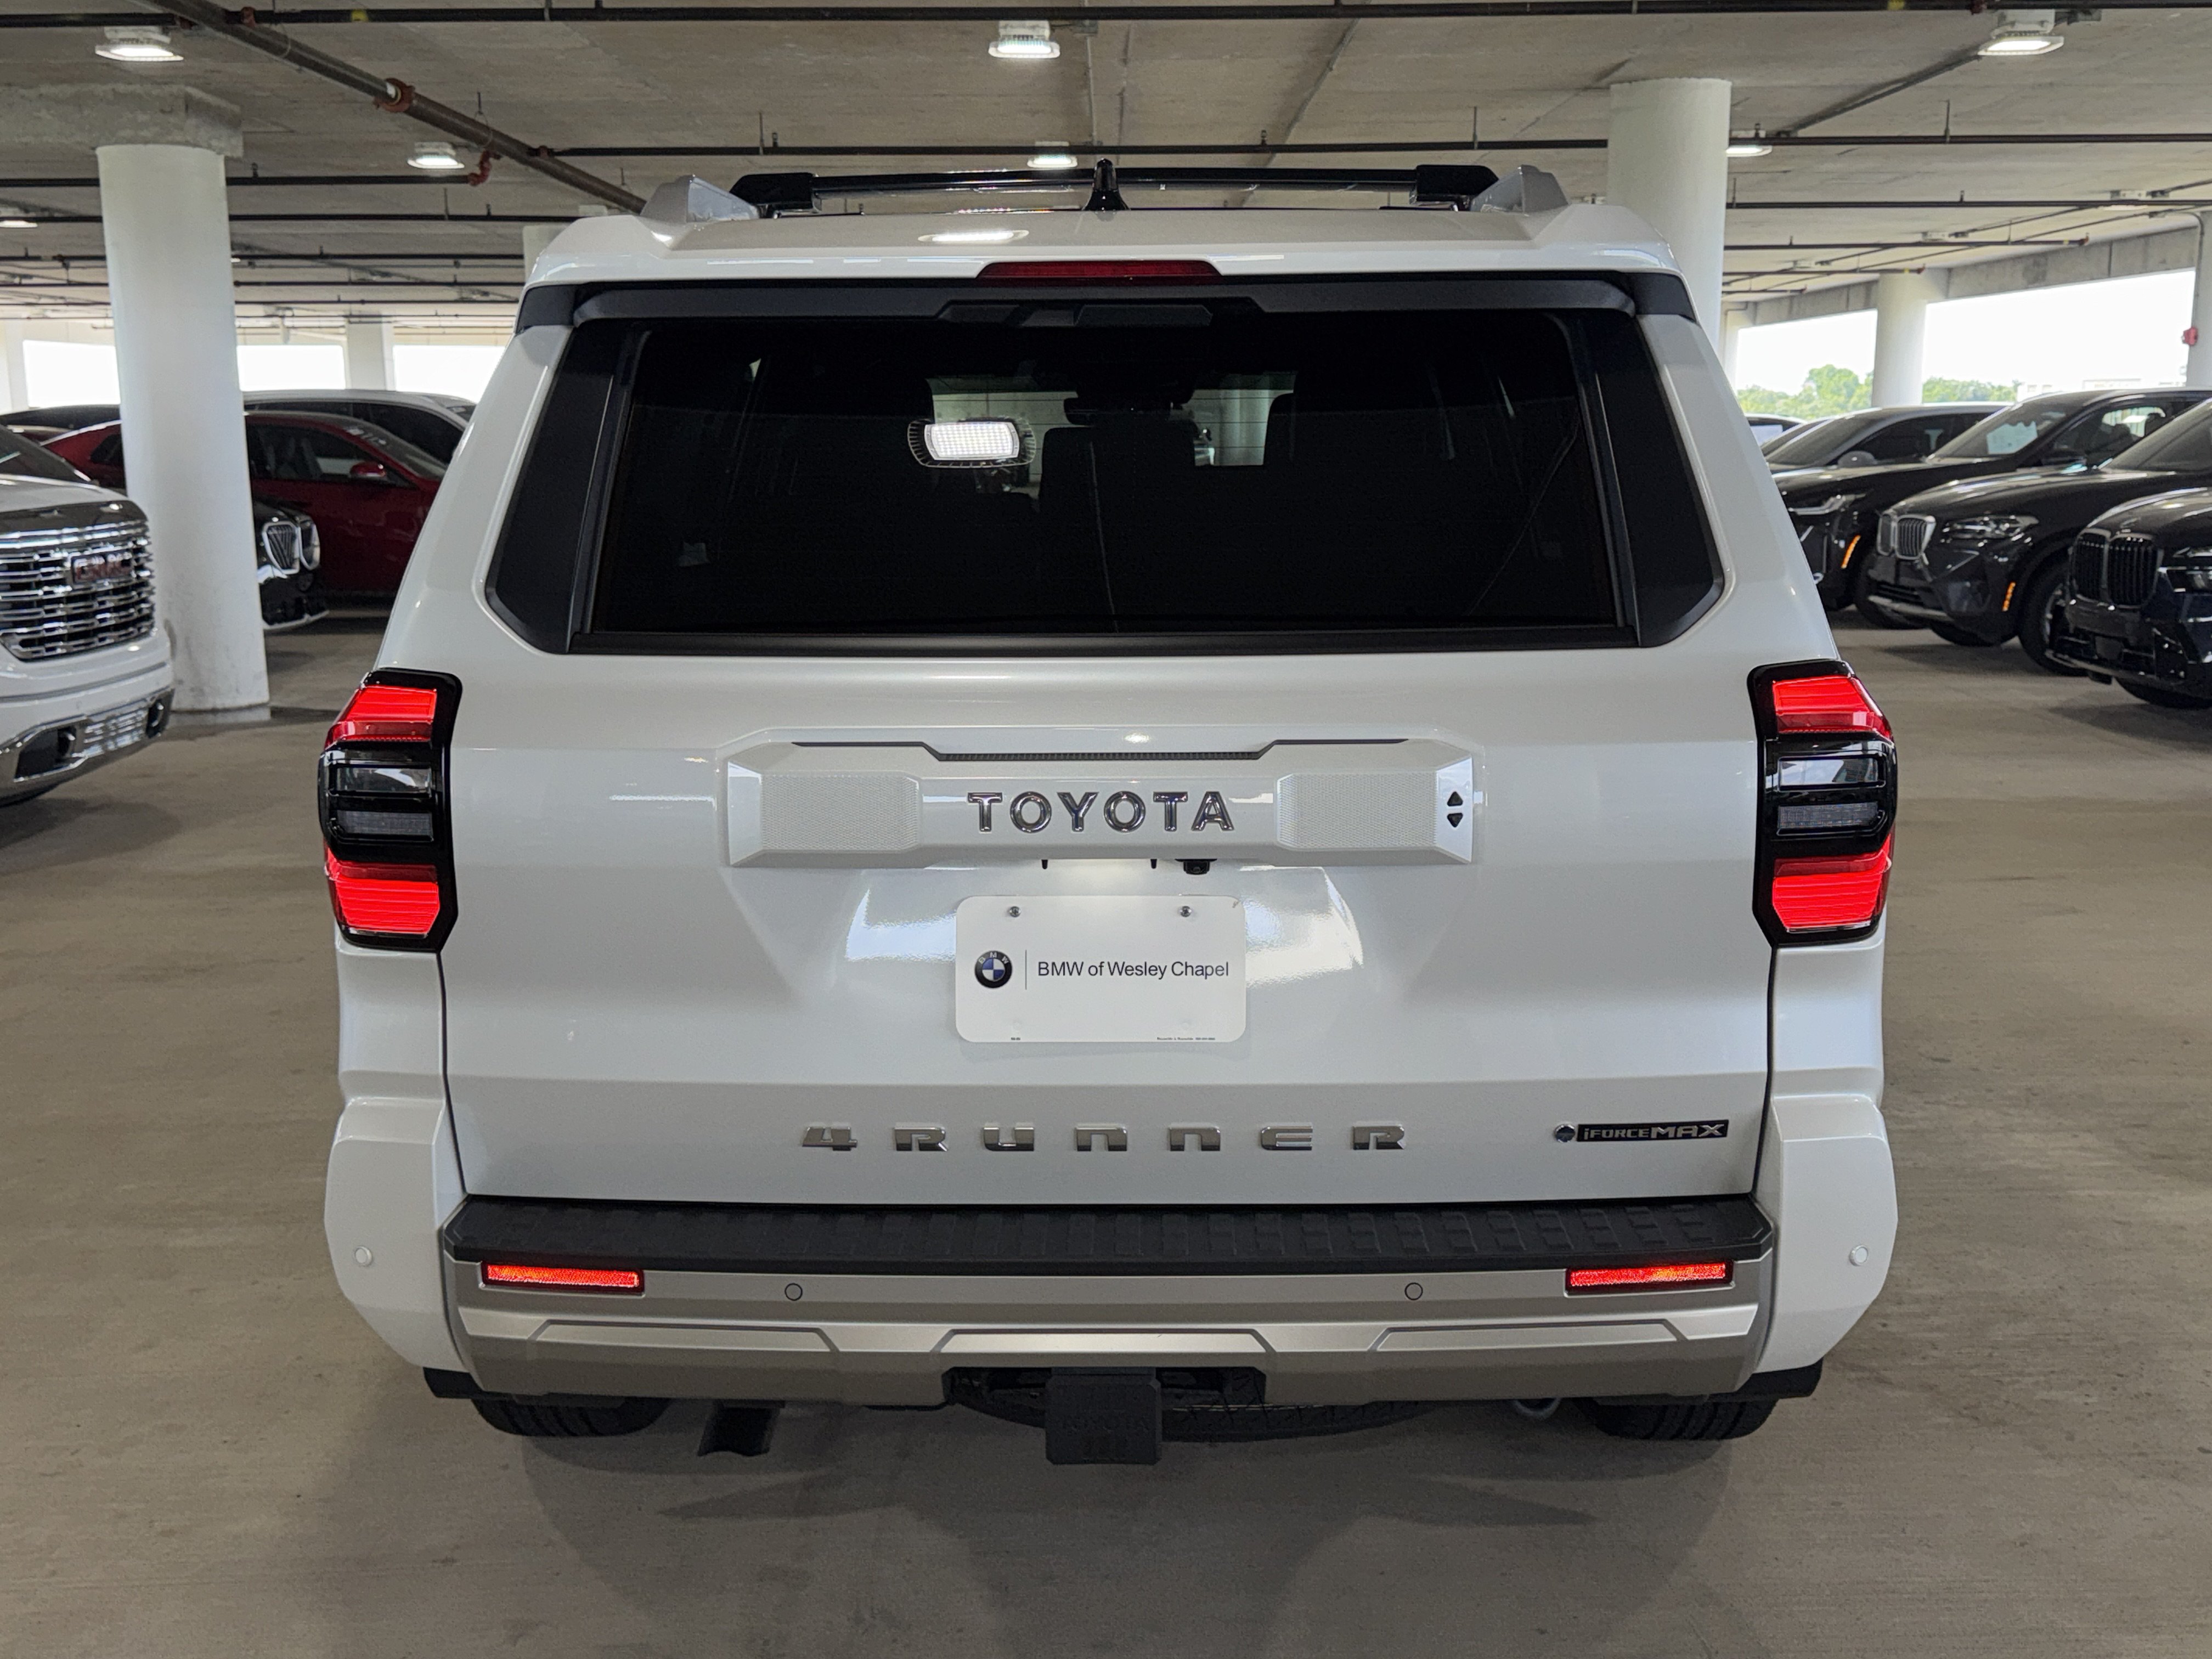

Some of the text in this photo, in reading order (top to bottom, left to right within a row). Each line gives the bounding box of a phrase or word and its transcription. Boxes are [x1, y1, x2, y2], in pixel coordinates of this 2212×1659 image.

[967, 791, 1235, 833] TOYOTA
[978, 952, 1009, 964] BMW
[1038, 961, 1229, 980] BMW of Wesley Chapel
